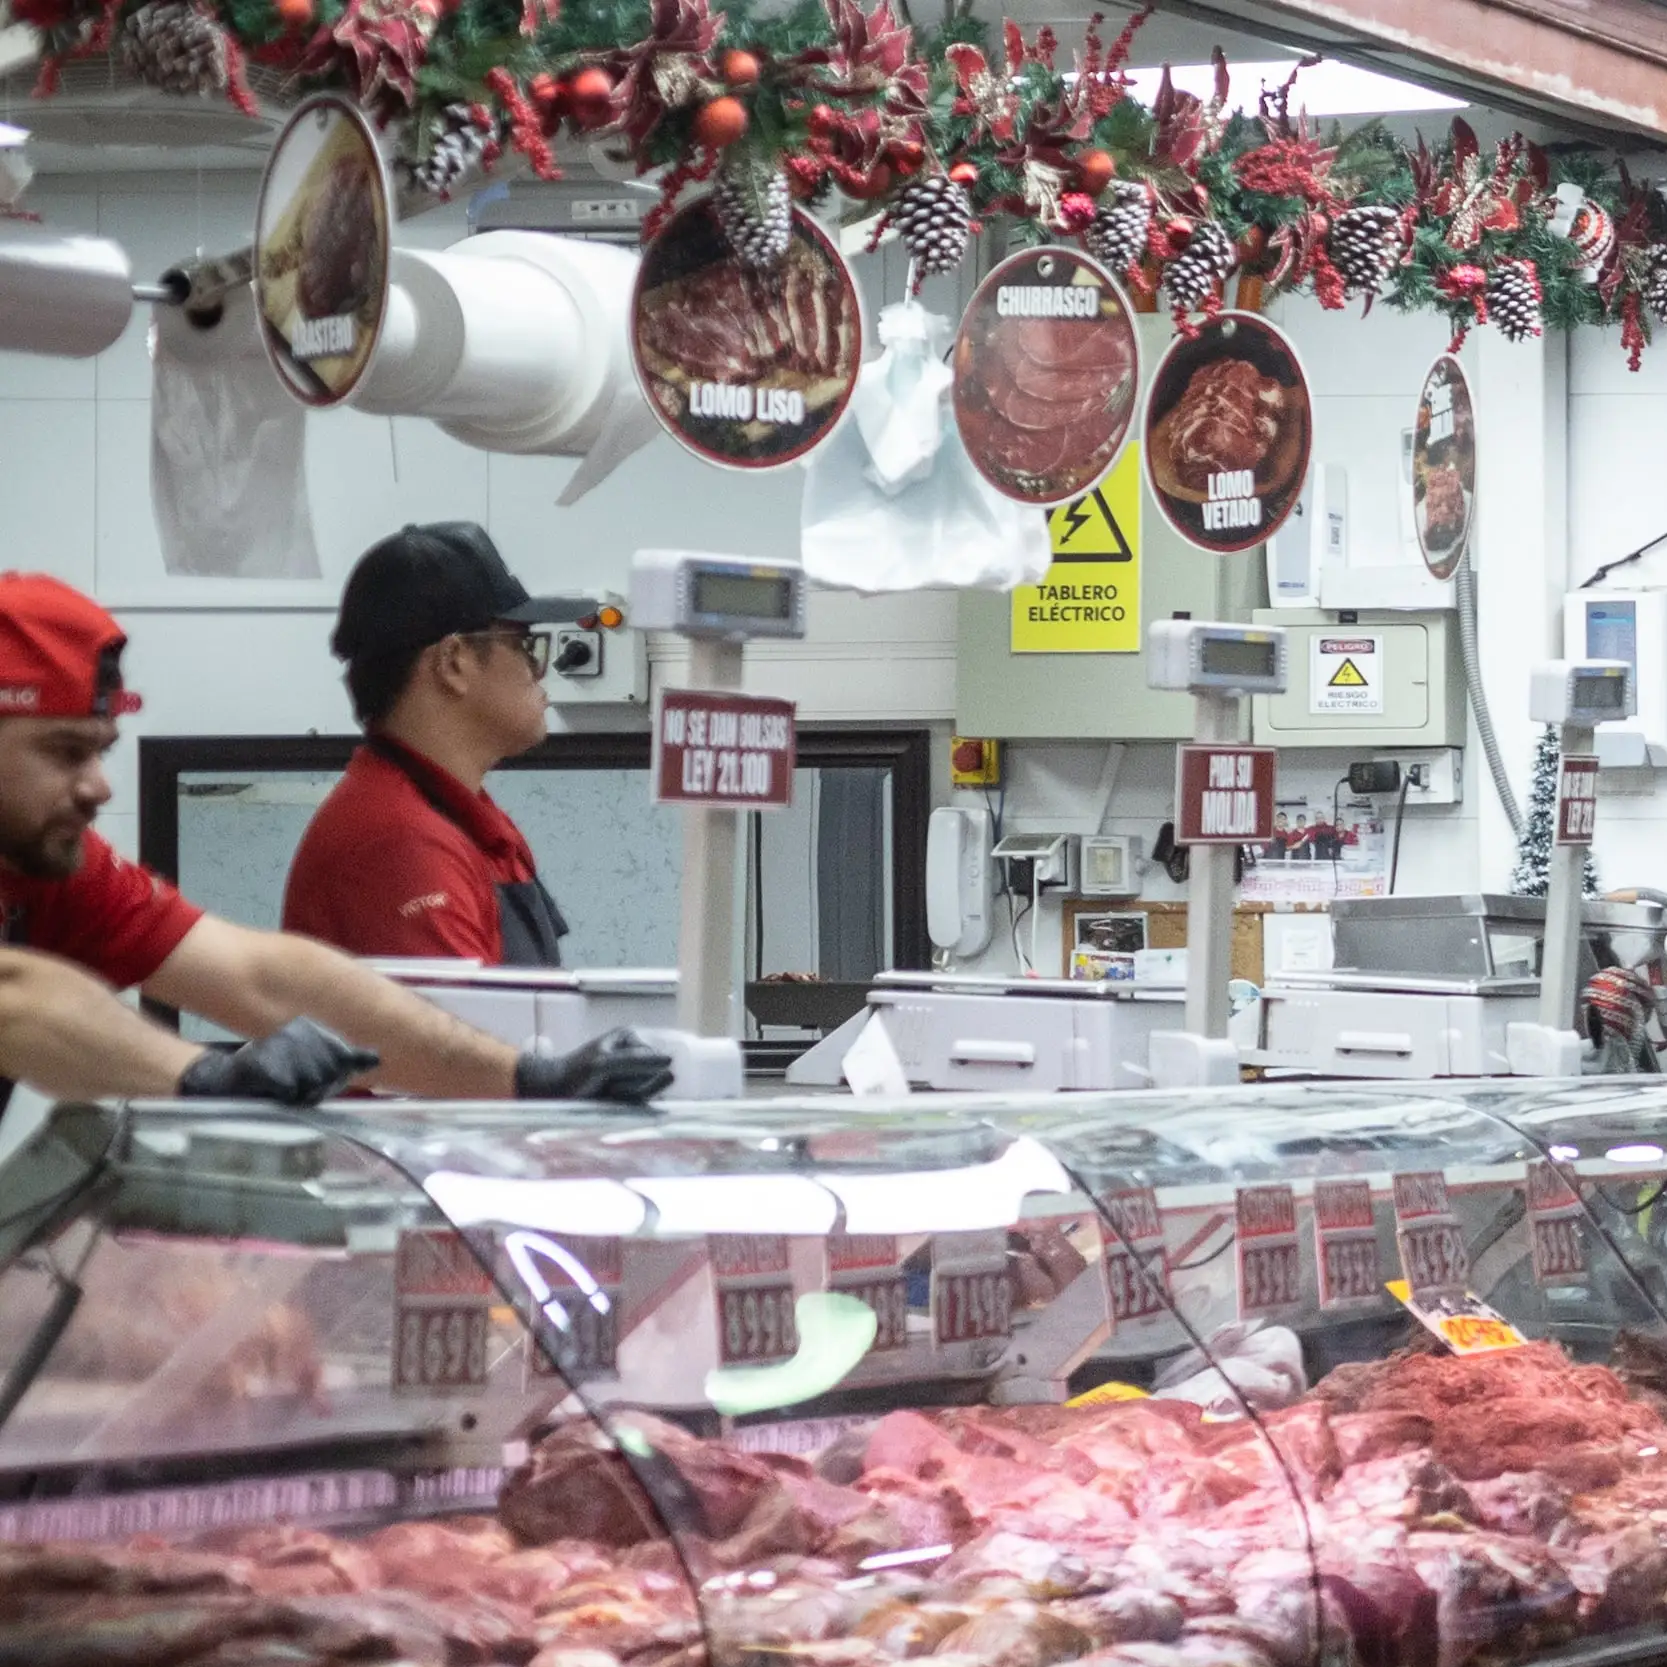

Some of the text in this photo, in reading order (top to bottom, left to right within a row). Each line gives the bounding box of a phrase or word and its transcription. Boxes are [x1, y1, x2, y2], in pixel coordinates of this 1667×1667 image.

[997, 286, 1099, 317] CHURRASCO
[689, 382, 804, 424] LOMO LISO
[1207, 469, 1254, 500] LOMO
[1202, 497, 1262, 530] VETADO
[1036, 584, 1118, 600] TABLERO
[1028, 602, 1126, 622] ELÉCTRICO
[1327, 691, 1368, 699] RIESGO
[663, 708, 788, 750] NO SE DAN BOLSAS
[682, 749, 715, 794] LEY
